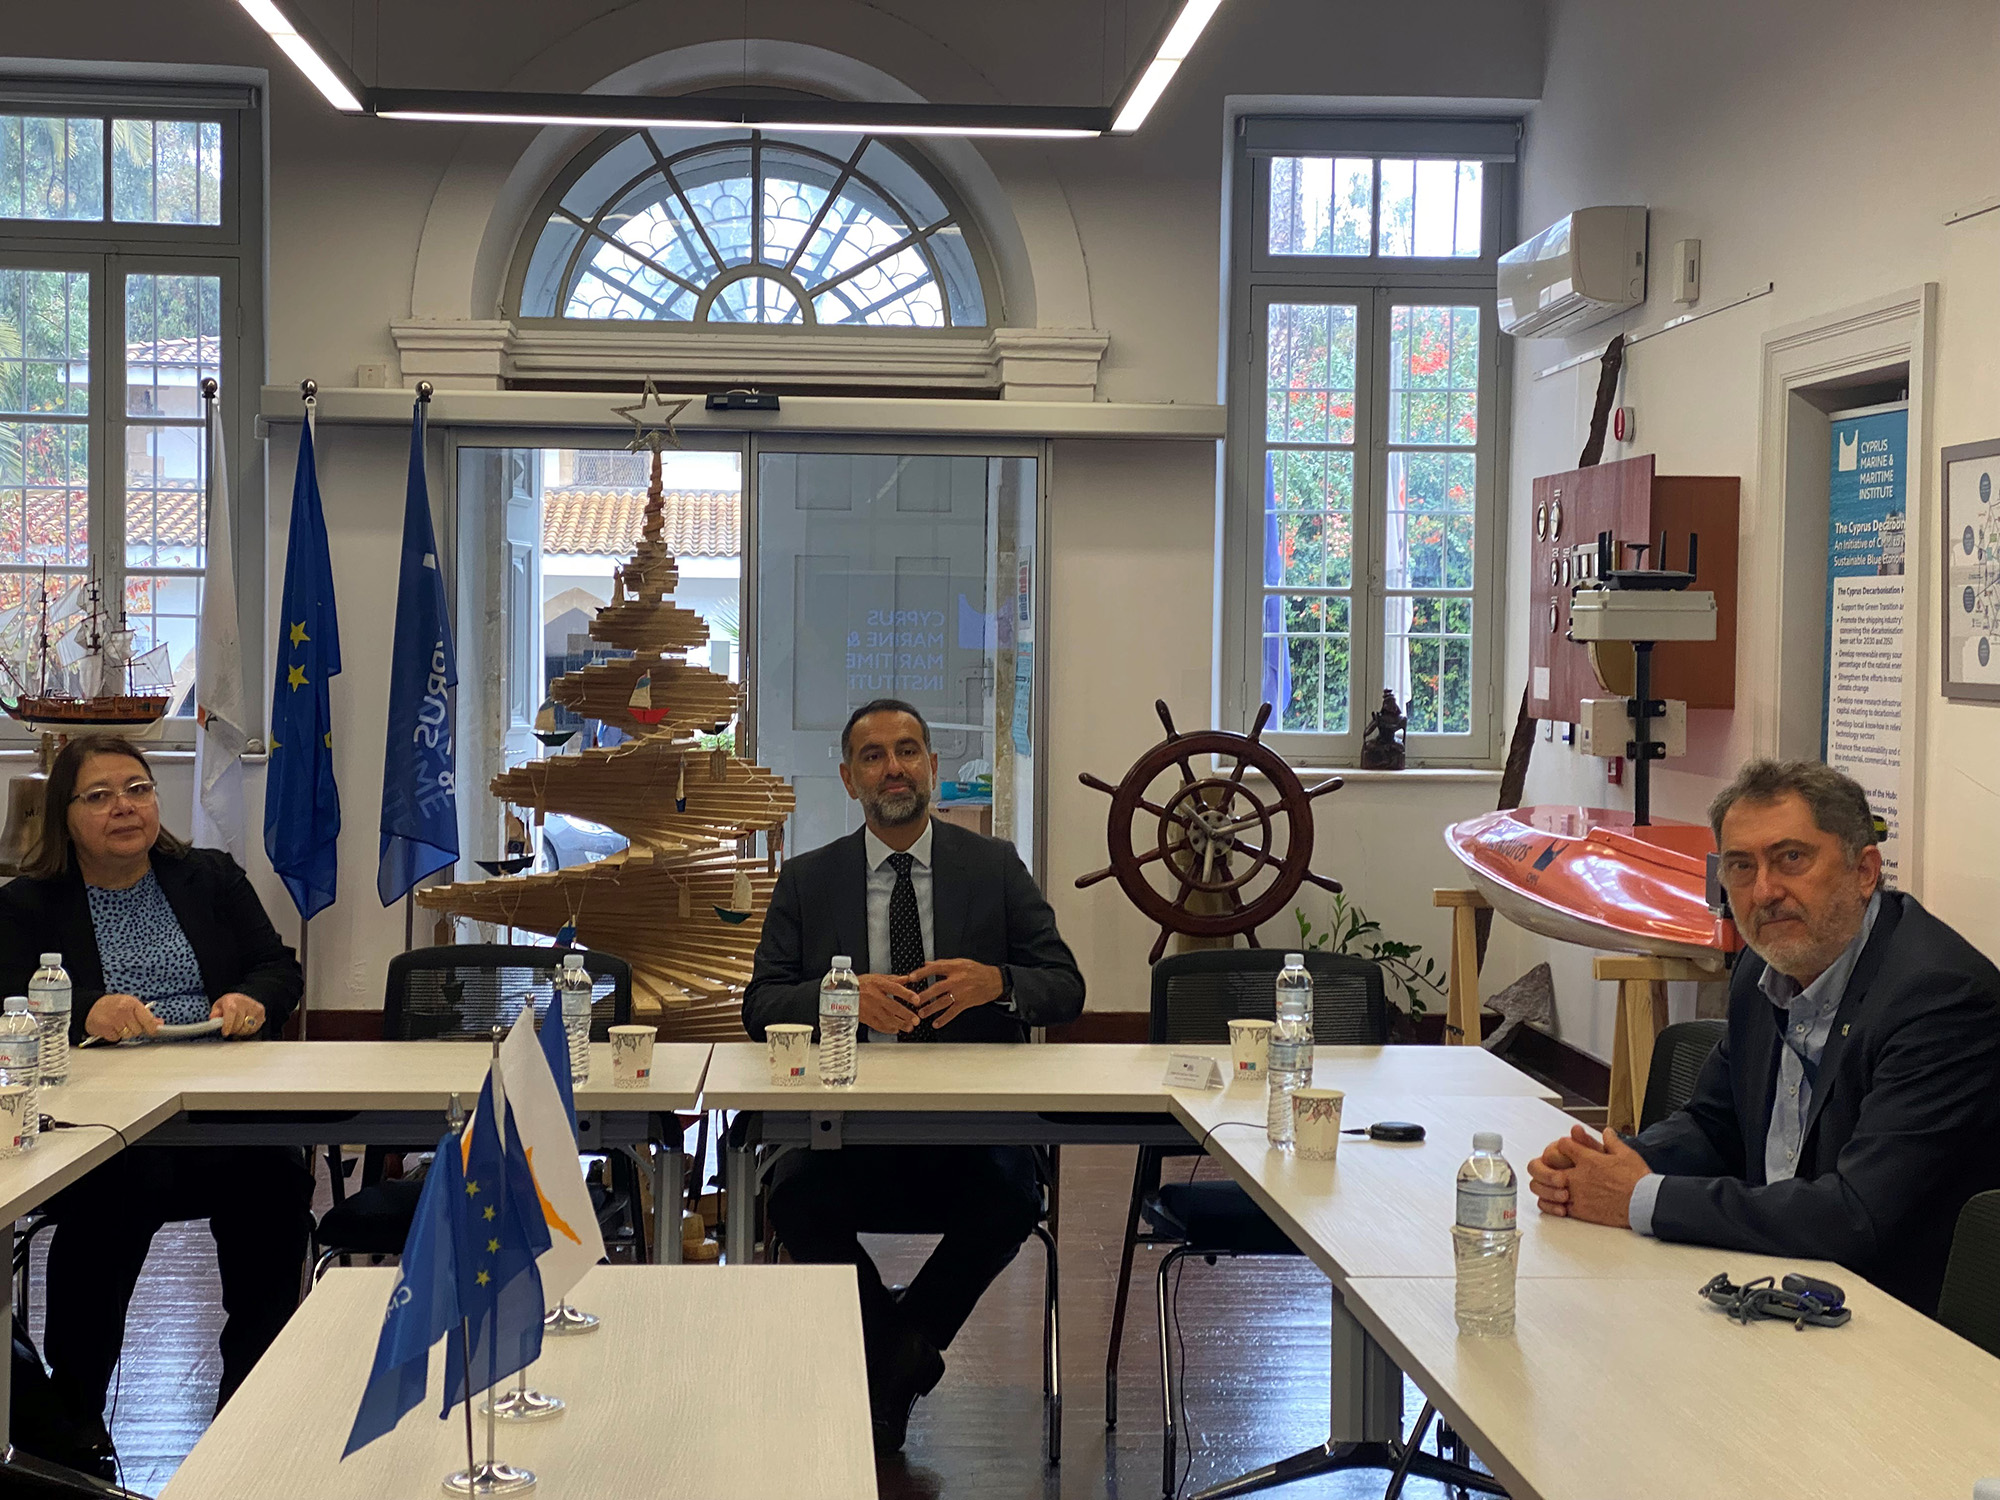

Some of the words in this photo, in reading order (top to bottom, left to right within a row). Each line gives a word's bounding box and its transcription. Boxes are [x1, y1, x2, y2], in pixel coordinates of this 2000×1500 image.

[1861, 439, 1888, 454] CYPRUS
[1860, 455, 1888, 469] MARINE
[1888, 454, 1894, 466] &
[1860, 470, 1894, 485] MARITIME
[1859, 485, 1894, 500] INSTITUTE
[1835, 522, 1847, 534] The
[1848, 521, 1871, 536] Cyprus
[1834, 540, 1843, 551] An
[1843, 538, 1868, 550] Initiative
[1868, 537, 1876, 548] of
[1834, 554, 1866, 567] Sustainable
[1867, 554, 1882, 565] Blue
[1838, 587, 1846, 595] The
[1847, 586, 1861, 597] Cyprus
[1862, 585, 1900, 595] Decarbonisation
